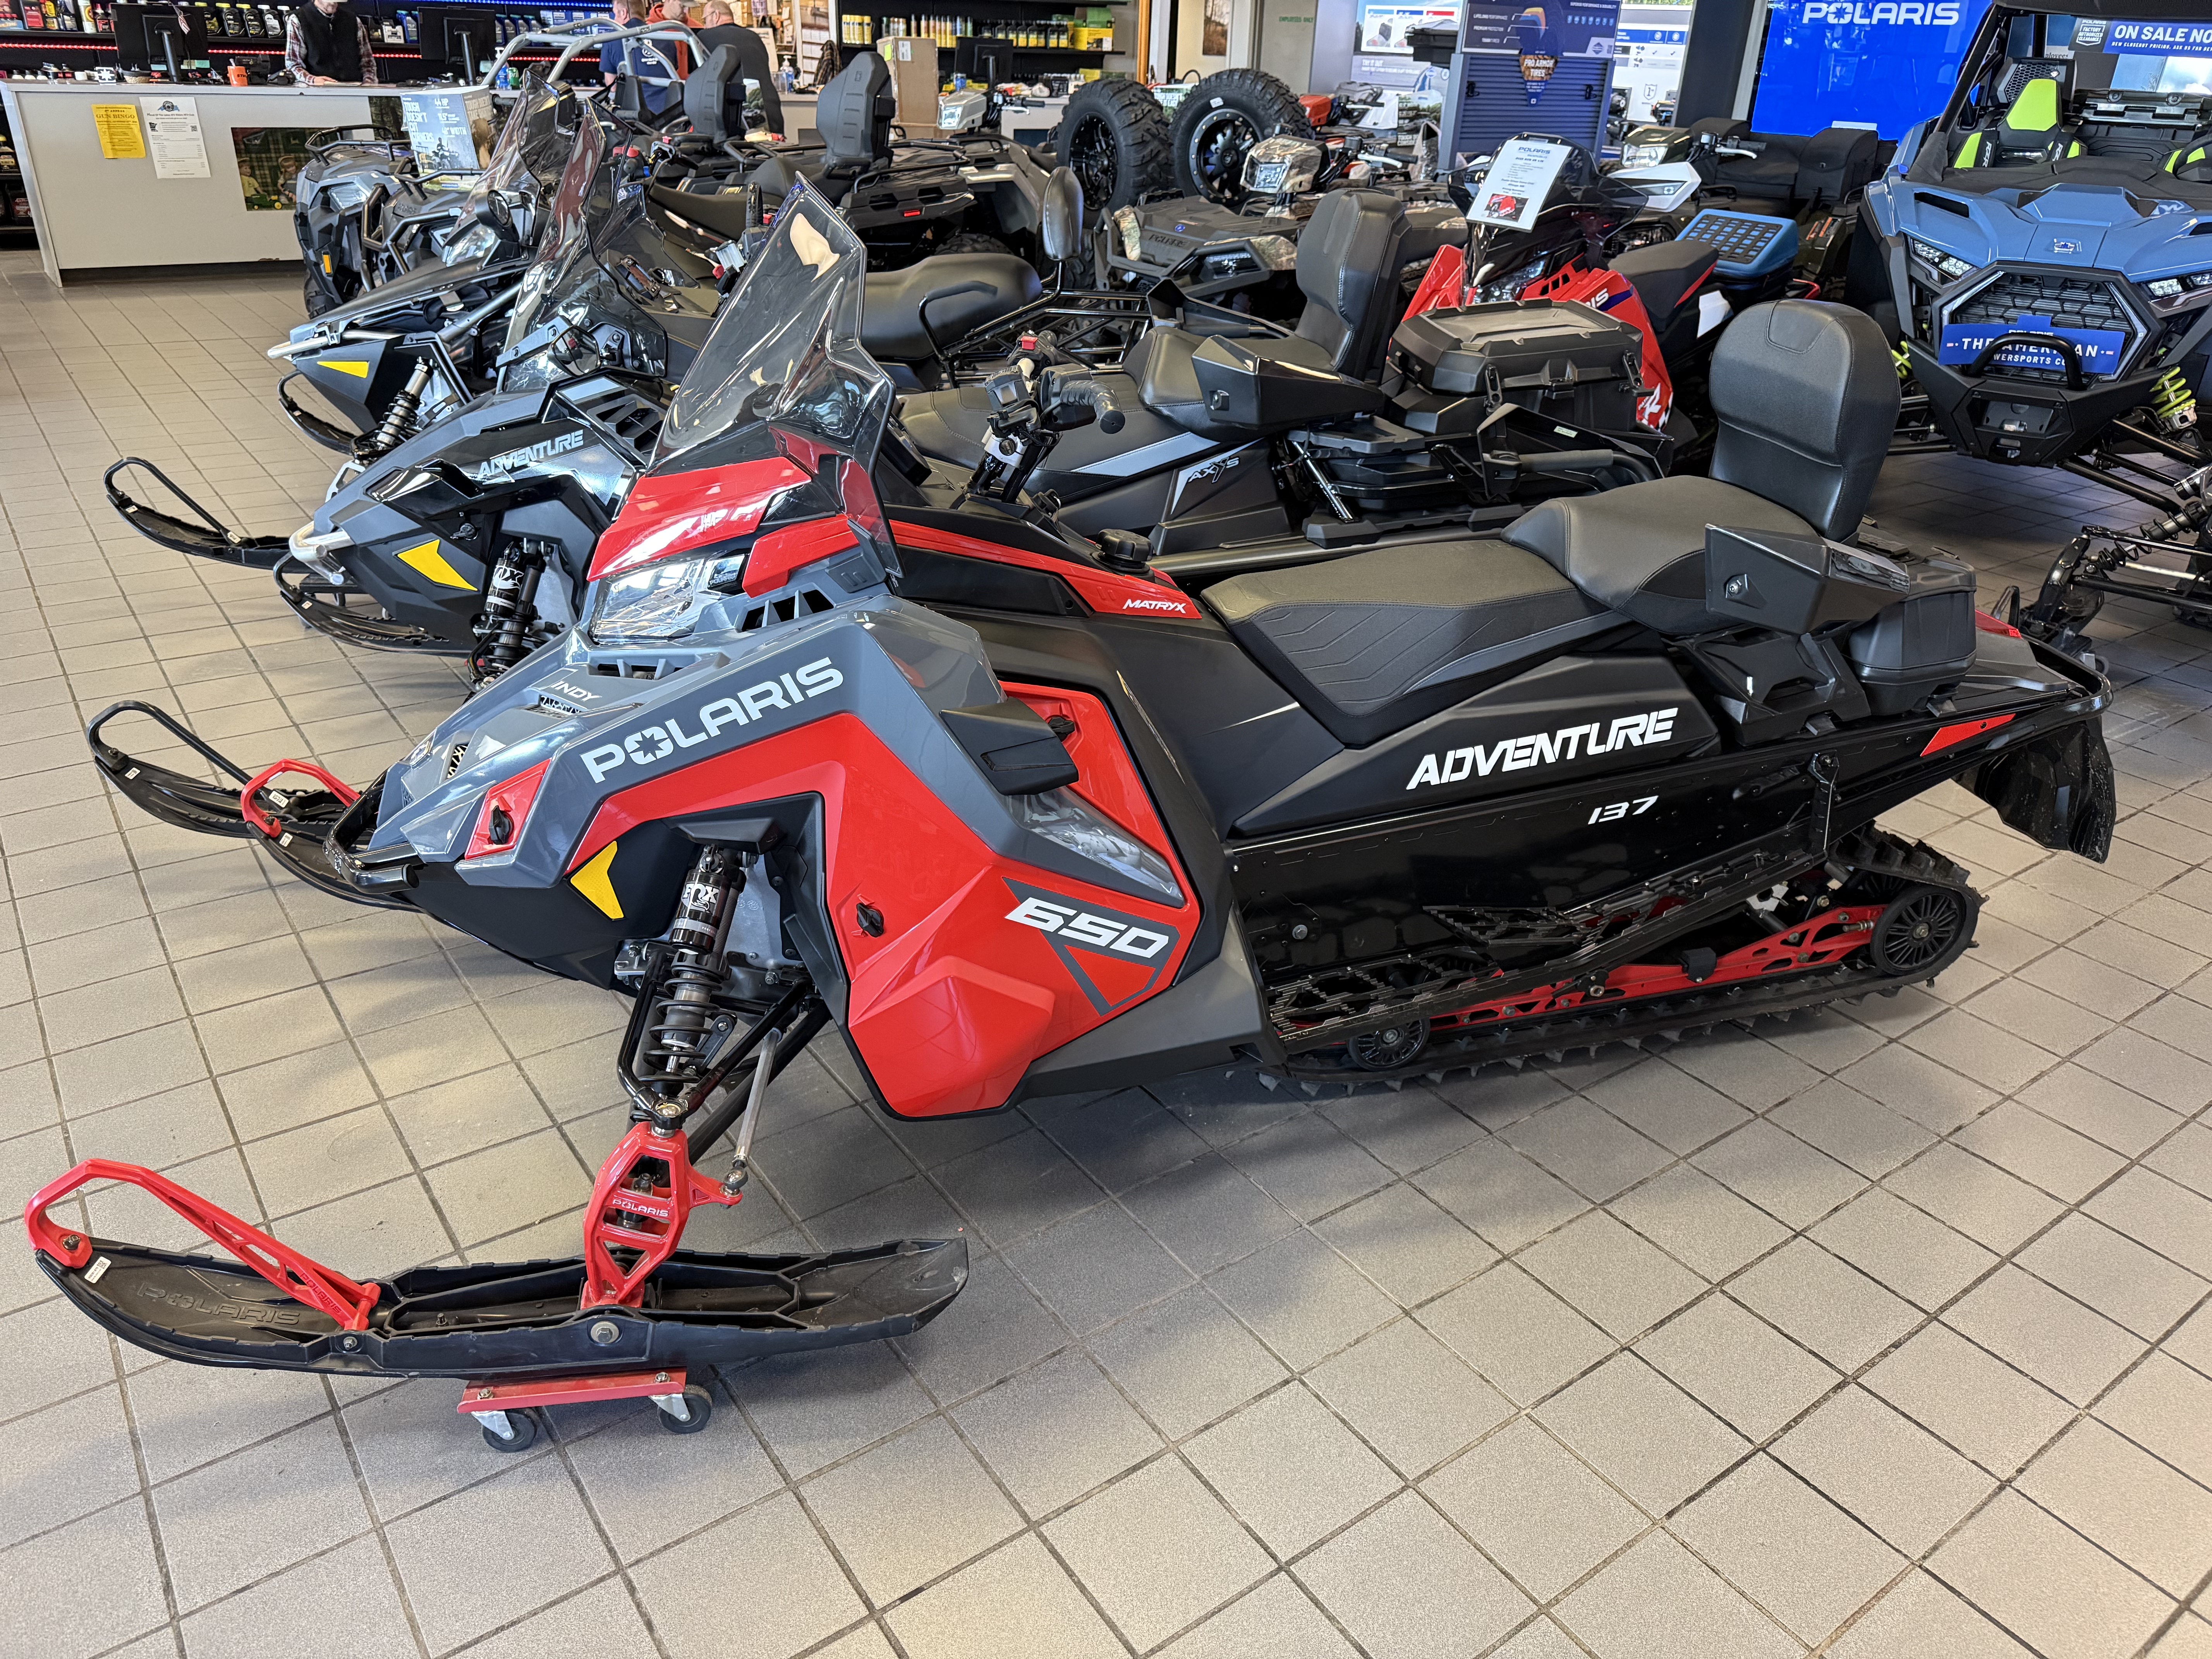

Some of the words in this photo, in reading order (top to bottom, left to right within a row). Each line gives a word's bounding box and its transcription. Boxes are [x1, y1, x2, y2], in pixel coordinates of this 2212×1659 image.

[1802, 2, 1960, 25] POLARIS
[2114, 25, 2140, 39] ON
[2141, 26, 2189, 42] SALE
[1530, 69, 1545, 77] TIRES
[1535, 59, 1555, 67] ARMOR
[404, 101, 421, 112] TOUGH
[449, 127, 467, 135] WIDTH
[1982, 141, 1992, 168] RZR
[2052, 143, 2063, 162] RZ
[477, 429, 584, 479] ADVENTURE
[1122, 599, 1187, 614] MATRYX
[550, 680, 603, 701] INDY
[580, 657, 844, 784] POLARIS
[1406, 707, 1678, 790] ADVENTURE
[1588, 795, 1659, 825] 137
[683, 882, 720, 912] FOX
[1004, 897, 1169, 958] 650
[612, 1198, 669, 1217] POLARIS
[137, 1282, 300, 1326] POLARIS
[301, 1272, 342, 1315] POLARIS
